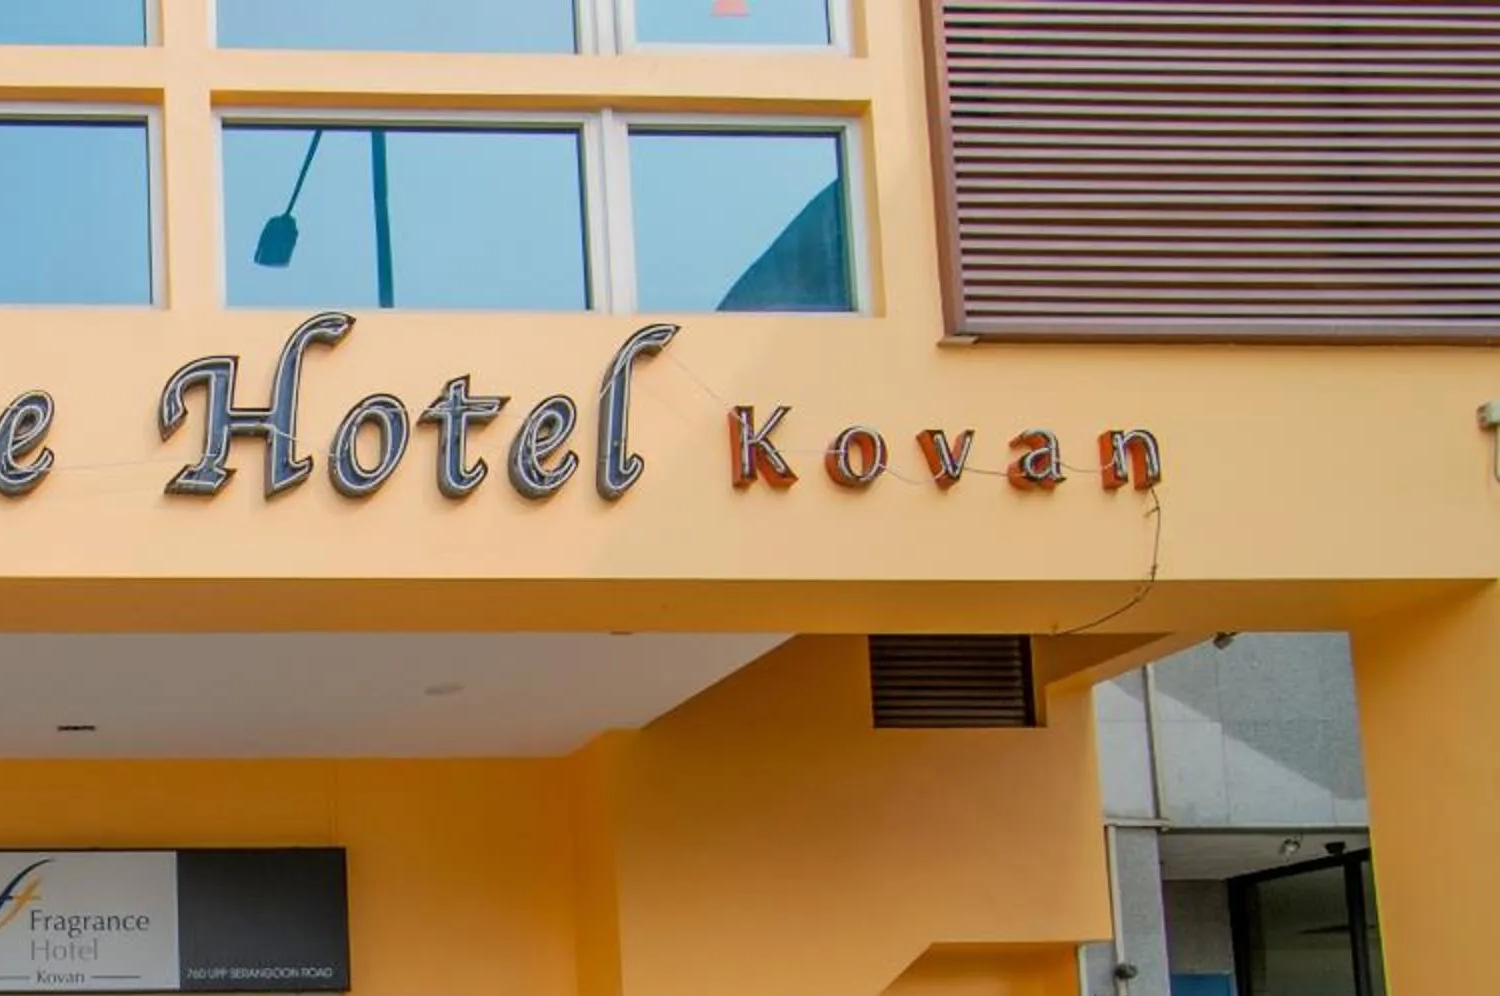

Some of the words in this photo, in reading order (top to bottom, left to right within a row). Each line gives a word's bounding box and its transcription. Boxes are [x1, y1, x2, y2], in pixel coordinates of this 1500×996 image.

[158, 311, 681, 500] Hotel
[727, 405, 1161, 489] Kovan
[30, 909, 150, 939] Fragrance
[30, 938, 99, 961] Hotel
[36, 969, 86, 984] Kovan
[187, 967, 206, 979] 760
[301, 966, 333, 978] ROAD
